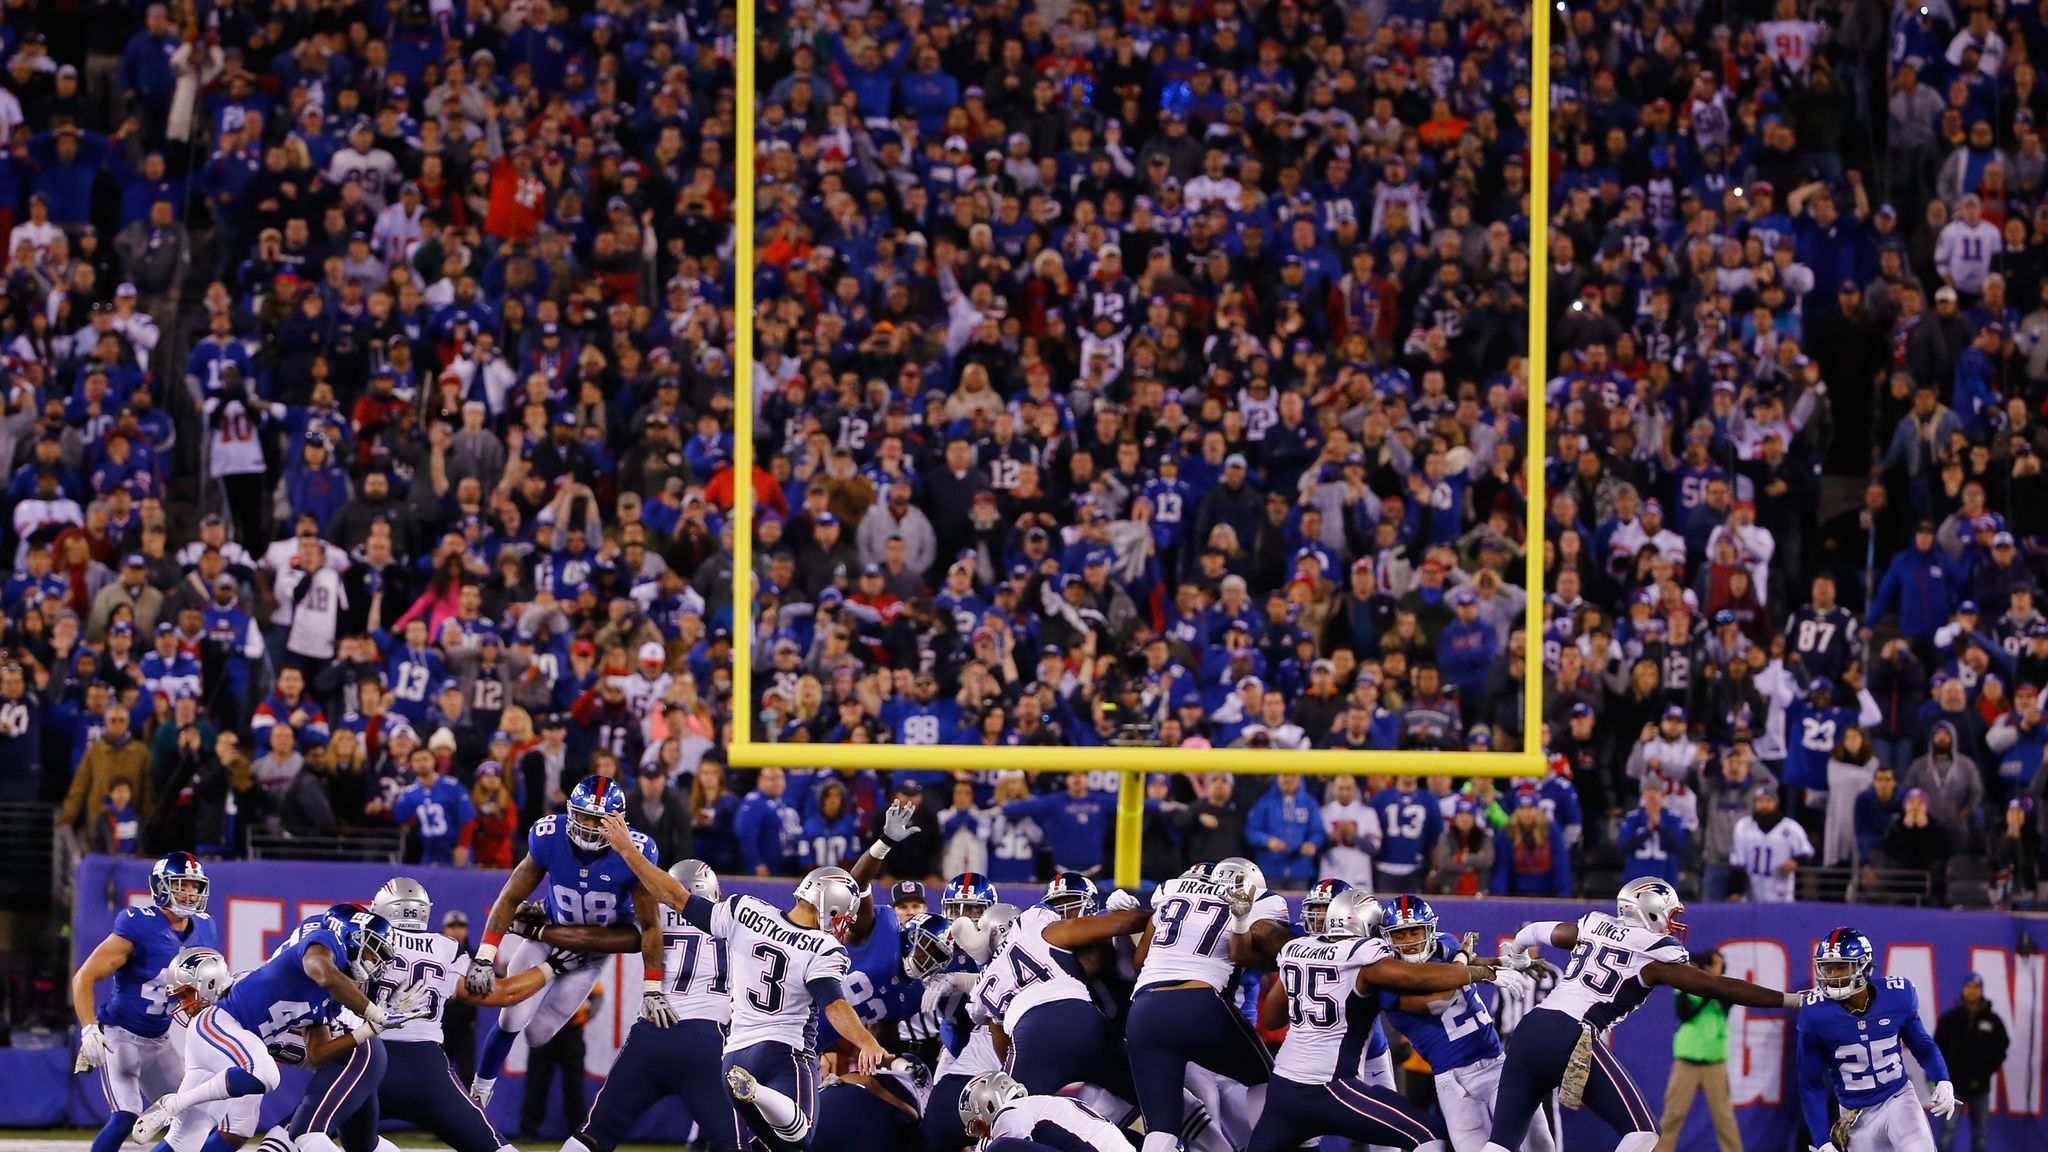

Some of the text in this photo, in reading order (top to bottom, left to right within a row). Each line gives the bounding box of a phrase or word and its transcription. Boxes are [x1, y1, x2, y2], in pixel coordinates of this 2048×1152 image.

[1776, 33, 1802, 58] 91
[1622, 234, 1650, 263] 12
[1961, 238, 1984, 262] 11
[1092, 291, 1125, 323] 12
[1644, 333, 1672, 362] 12
[222, 412, 252, 444] 10
[838, 415, 869, 450] 12
[989, 459, 1021, 490] 12
[1156, 493, 1183, 523] 13
[307, 587, 330, 612] 18
[1797, 620, 1837, 654] 87
[398, 661, 429, 702] 13
[1663, 656, 1691, 689] 12
[473, 680, 503, 710] 12
[903, 715, 939, 745] 98
[1802, 717, 1836, 752] 23
[416, 804, 447, 836] 13
[1385, 804, 1425, 840] 13
[1218, 870, 1235, 878] 97
[1753, 845, 1773, 877] 11
[804, 881, 812, 891] 3
[1177, 881, 1232, 897] BRANC
[553, 884, 617, 927] 98
[737, 906, 826, 954] GOSTKOWSKI
[1151, 896, 1232, 958] 97
[1330, 917, 1344, 929] 85
[1591, 920, 1631, 942] JONES
[397, 932, 435, 954] TORK
[1284, 943, 1338, 961] WILLIAMS
[663, 931, 731, 997] 71
[746, 941, 791, 1017] 3
[140, 968, 181, 1016] 4
[977, 941, 1055, 1022] 64
[1281, 961, 1341, 1030] 85
[1835, 1034, 1903, 1091] 25
